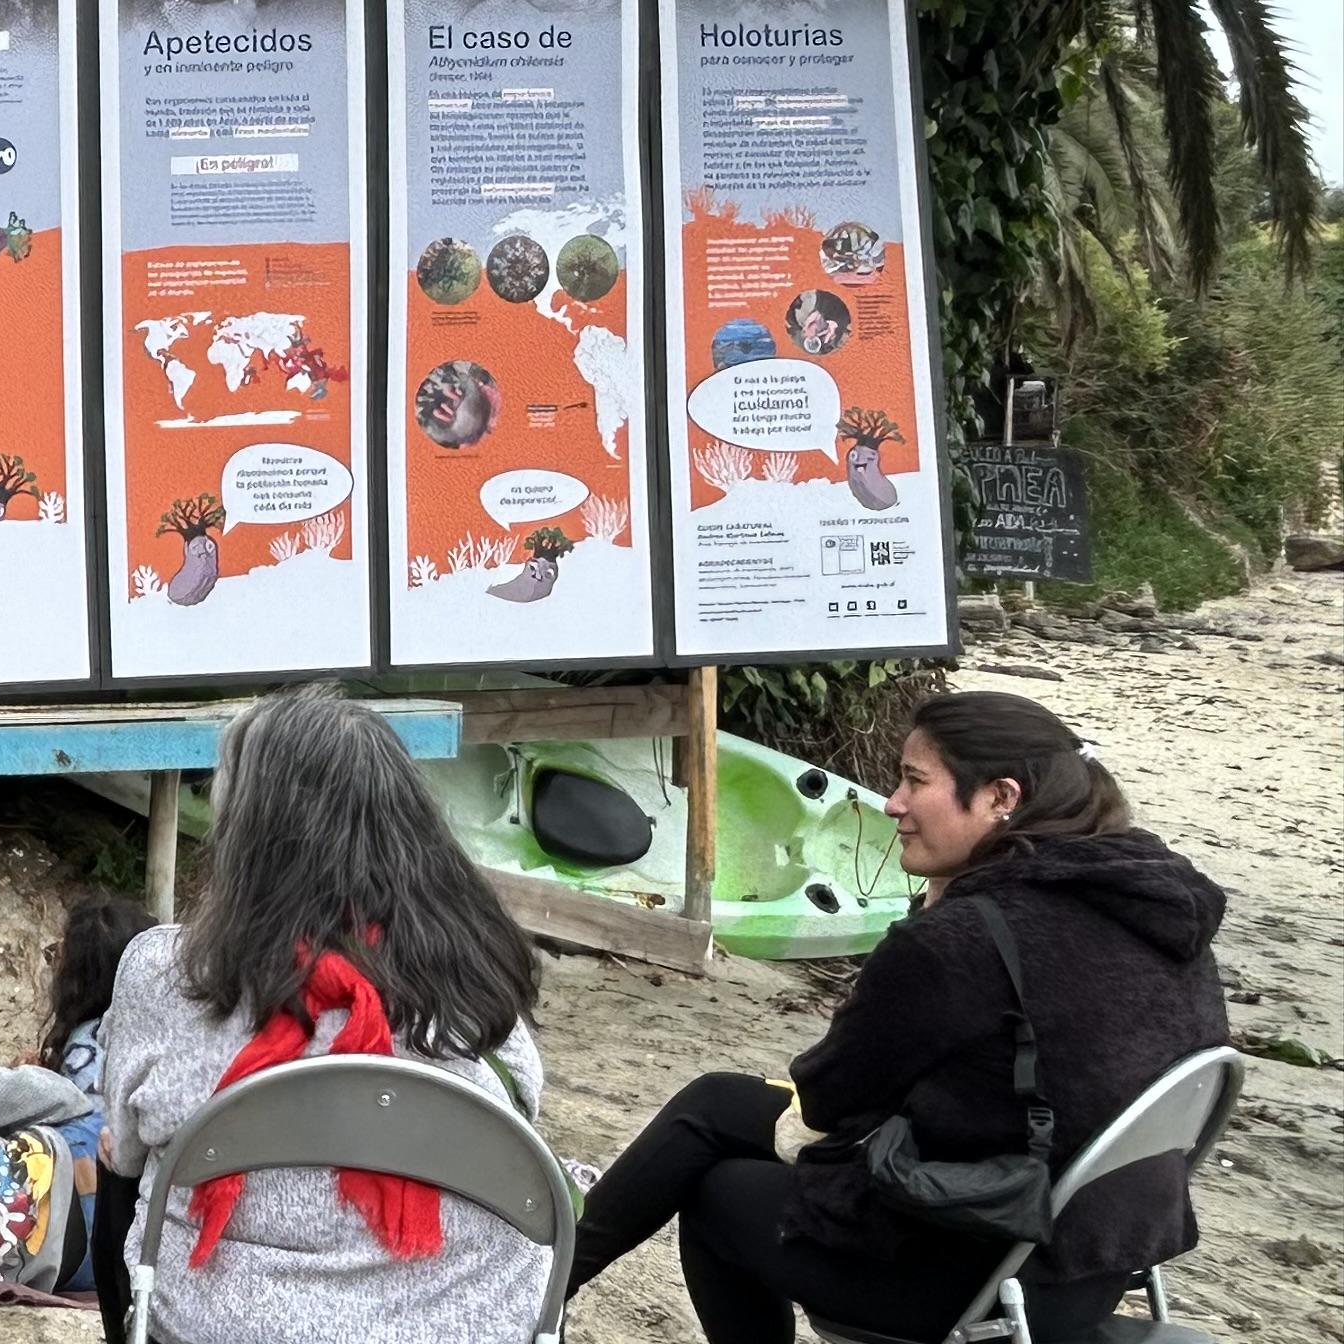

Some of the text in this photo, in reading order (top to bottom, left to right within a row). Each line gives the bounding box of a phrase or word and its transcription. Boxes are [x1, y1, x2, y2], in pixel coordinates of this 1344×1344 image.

[143, 28, 313, 60] Apetecidos
[428, 24, 573, 50] El caso de
[700, 23, 844, 48] Holoturias
[246, 60, 295, 74] peligro
[700, 54, 855, 68] para conocer y proteger
